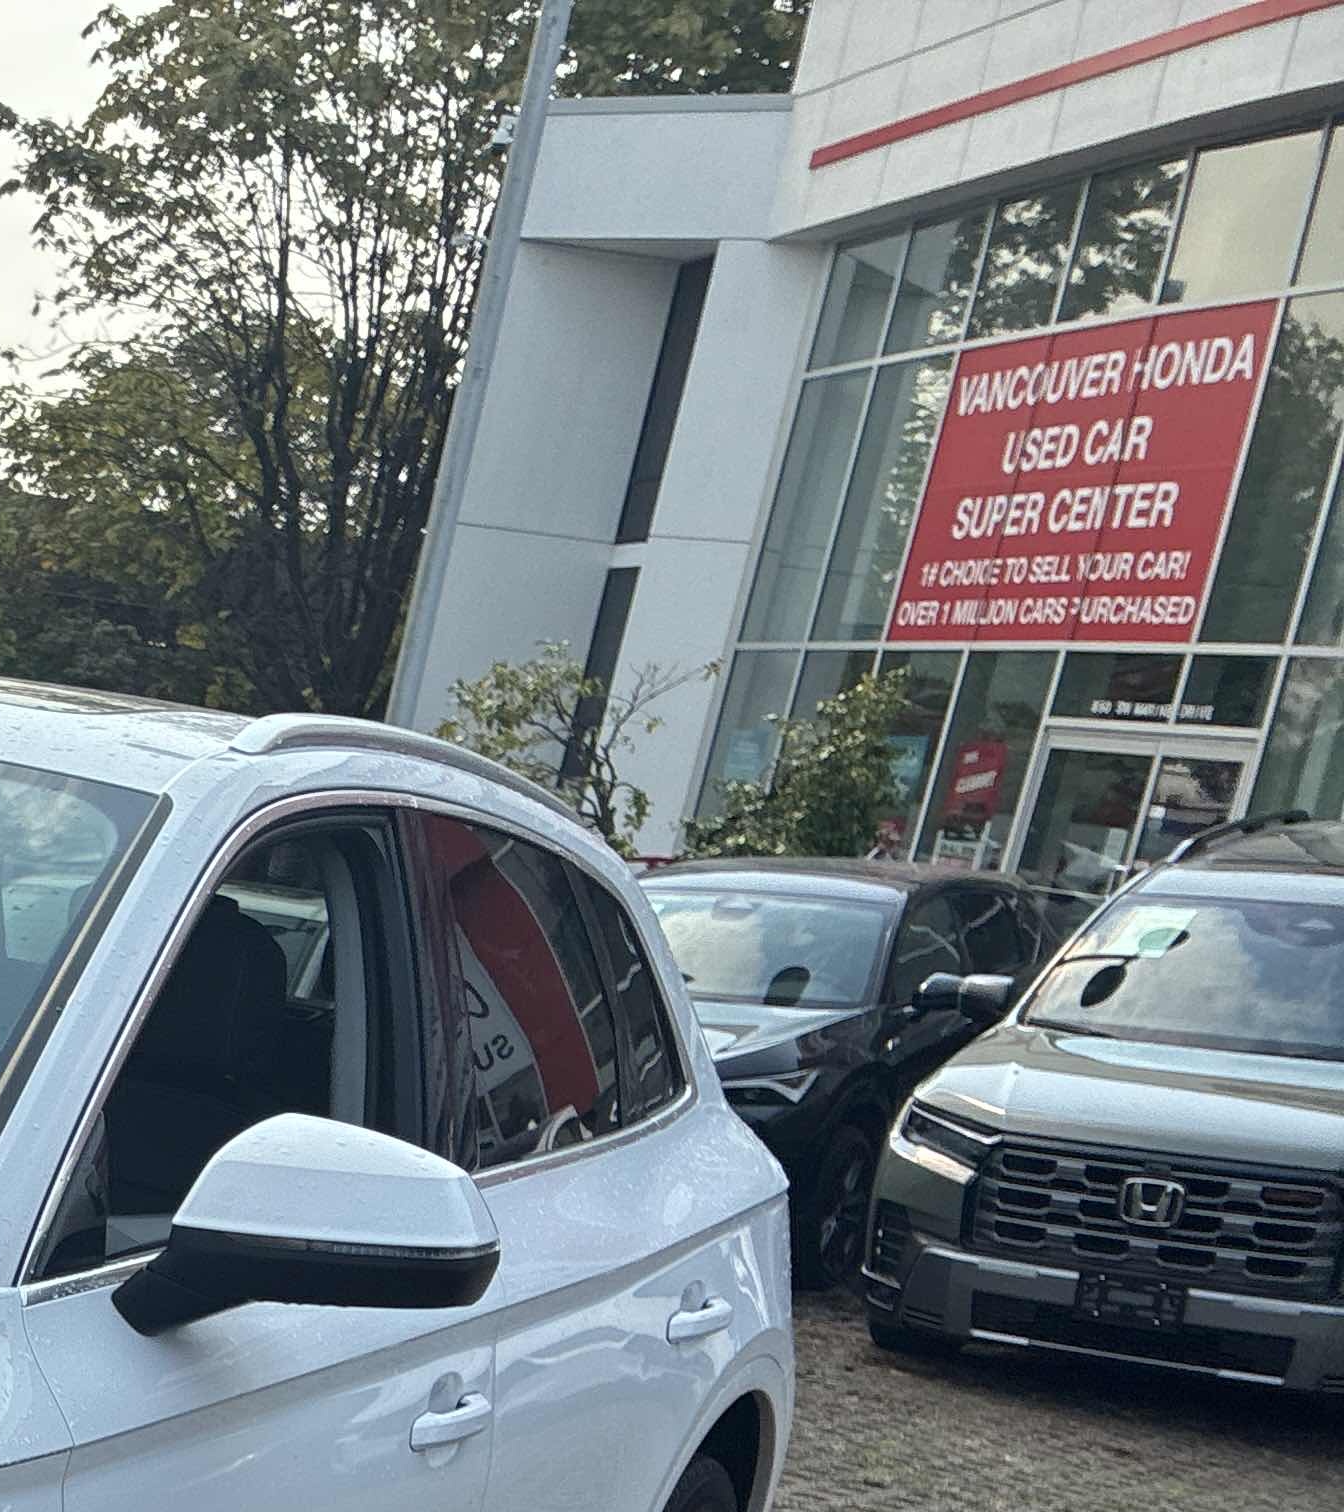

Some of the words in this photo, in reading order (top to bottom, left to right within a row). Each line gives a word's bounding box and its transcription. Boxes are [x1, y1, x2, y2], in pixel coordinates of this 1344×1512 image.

[955, 349, 1127, 417] VANCOUVER
[1128, 333, 1255, 392] HONDA
[1002, 424, 1080, 474] USED
[1085, 415, 1153, 467] CAR
[952, 491, 1045, 540] SUPER
[1048, 481, 1180, 533] CENTER
[920, 563, 938, 588] 1#
[939, 558, 1000, 586] CHOICE
[1003, 557, 1027, 584] TO
[1029, 555, 1072, 583] SELL
[1077, 552, 1134, 582] YOUR
[1136, 550, 1192, 580] CAR!
[897, 601, 939, 626] OVER
[942, 601, 950, 626] 1
[1018, 598, 1067, 625] CARS
